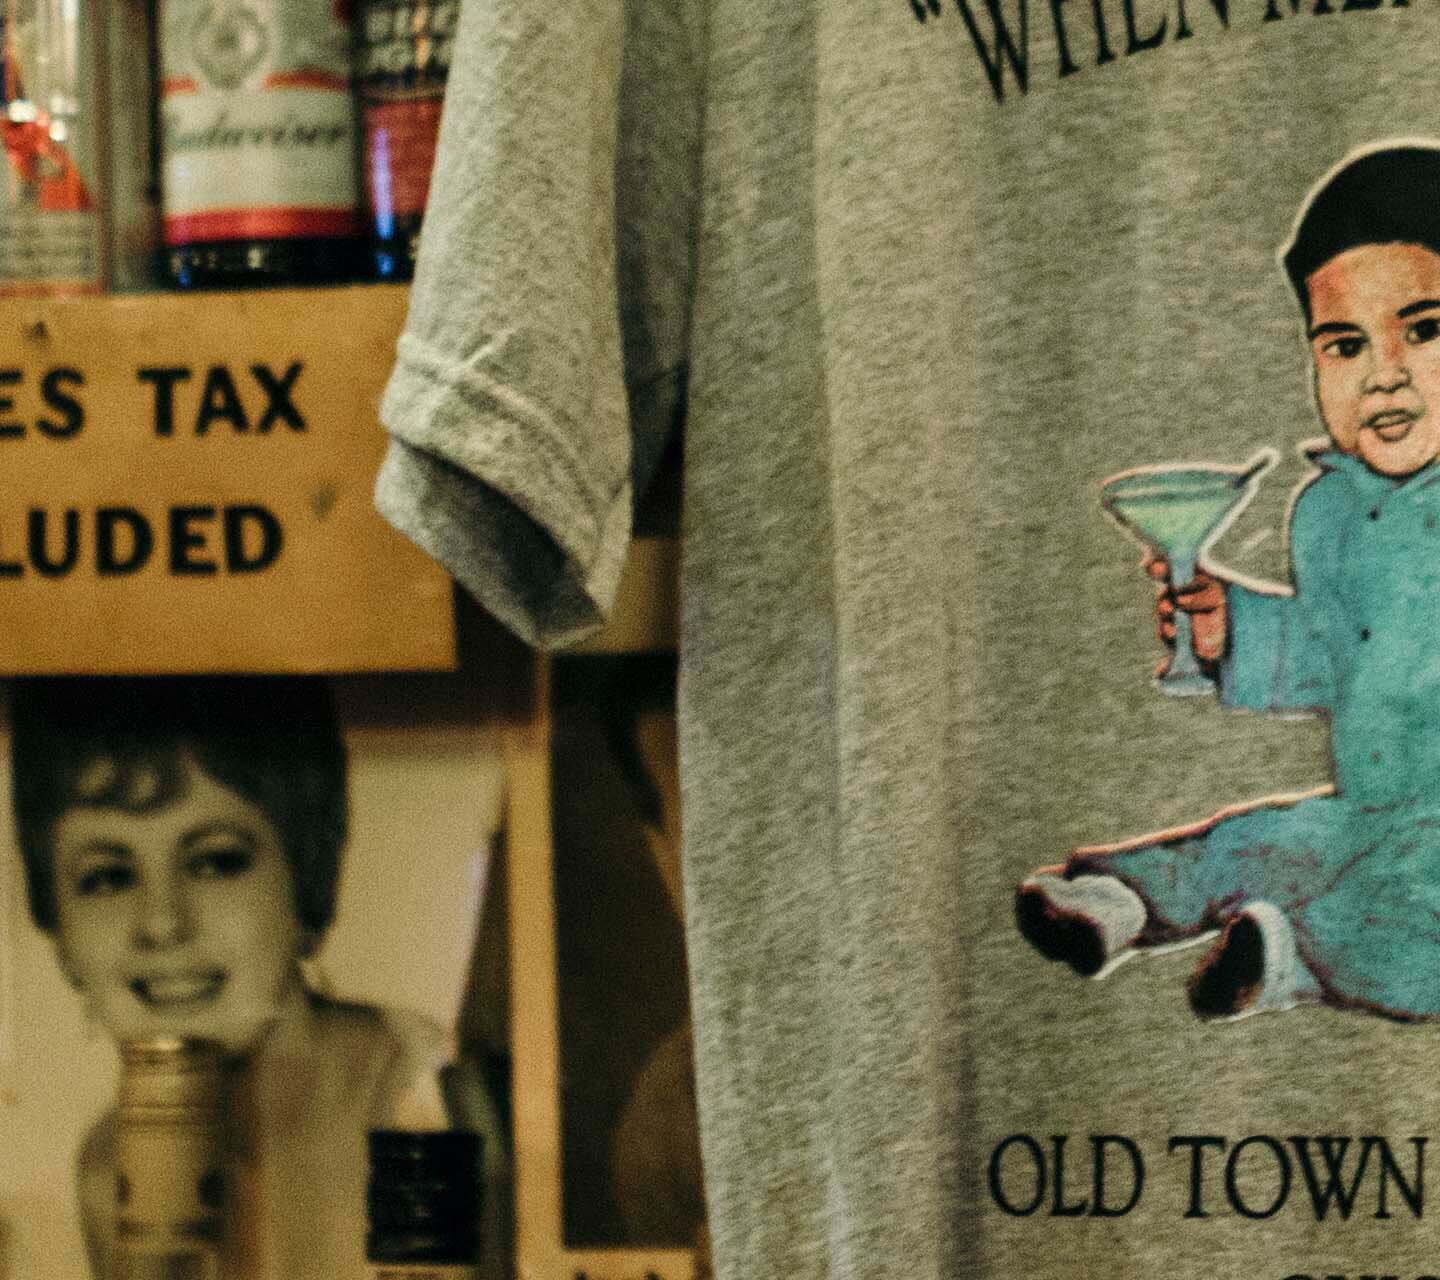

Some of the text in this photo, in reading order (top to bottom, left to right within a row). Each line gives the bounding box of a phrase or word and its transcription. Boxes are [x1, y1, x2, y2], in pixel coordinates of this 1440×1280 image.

[138, 360, 308, 438] TAX
[986, 1133, 1145, 1219] OLD
[1168, 1134, 1430, 1221] TOWN
